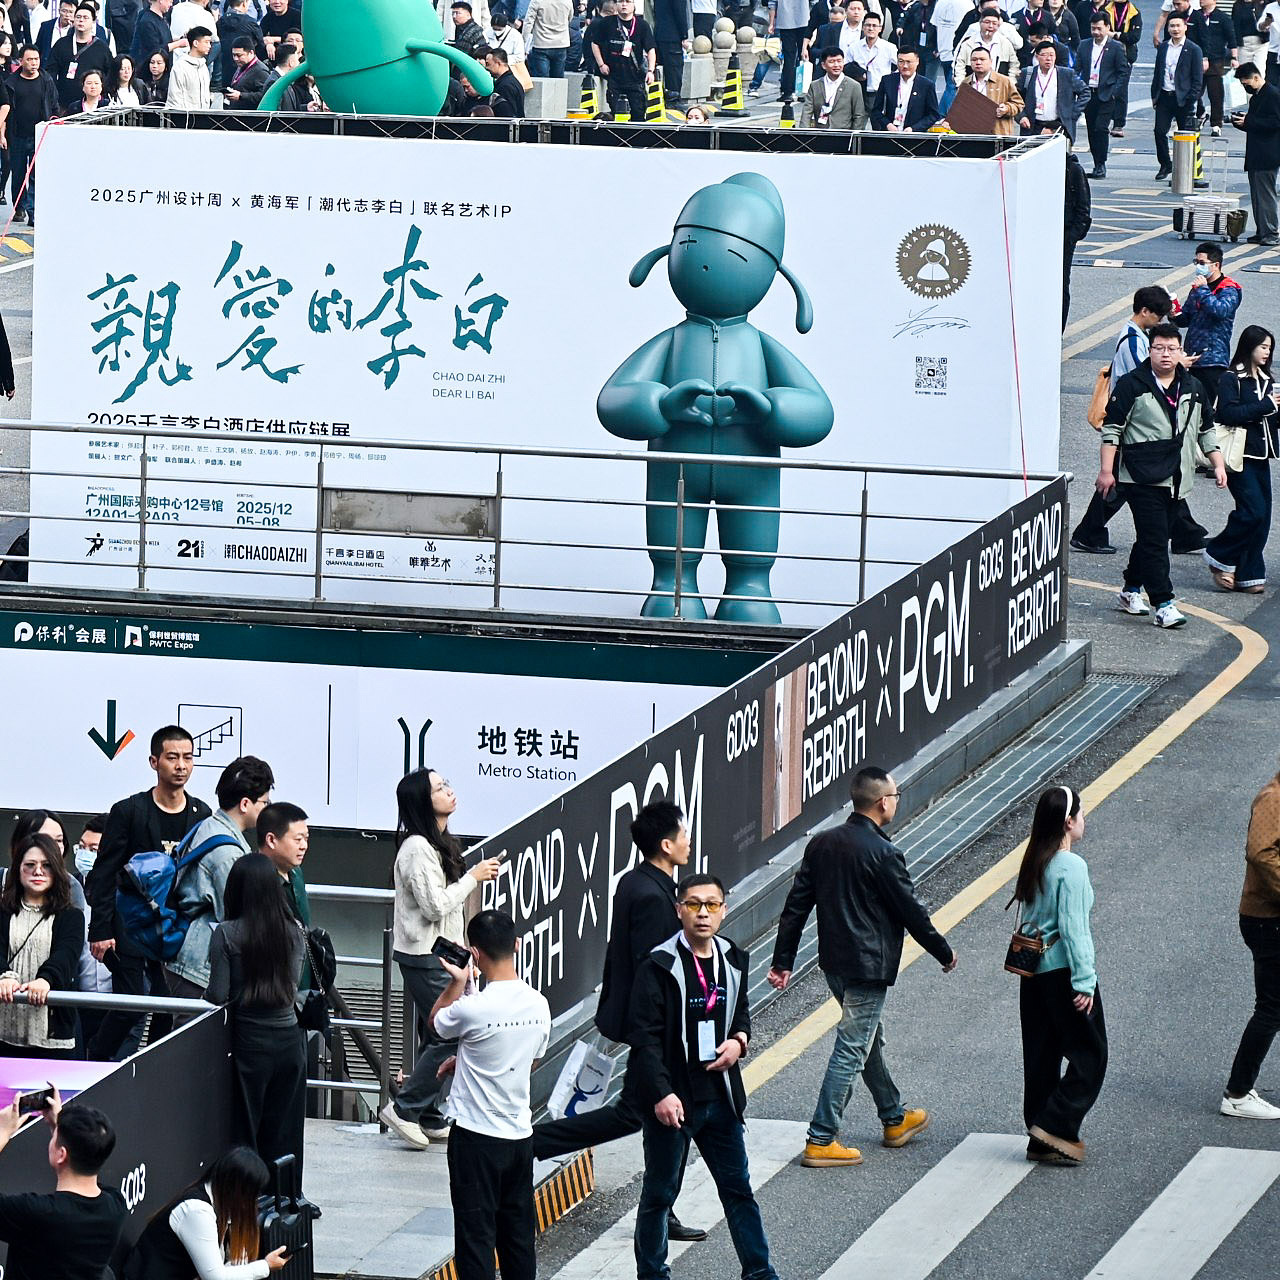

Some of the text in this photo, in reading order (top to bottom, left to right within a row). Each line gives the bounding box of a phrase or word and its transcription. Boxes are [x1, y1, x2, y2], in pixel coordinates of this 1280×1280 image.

[90, 188, 223, 209] 2025广州设计周
[432, 372, 506, 384] CHAO DAI ZHI
[433, 389, 495, 401] DEAR LI BAI
[236, 501, 293, 516] 2025/12
[1010, 502, 1061, 588] BEYOND
[366, 561, 385, 569] HOTEL
[1007, 566, 1061, 659] REBIRTH
[36, 624, 107, 645] 保利 会展
[148, 630, 200, 643] 保利世贸博览馆
[149, 639, 194, 650] PWTC Expo
[806, 629, 869, 728] BEYOND
[477, 724, 581, 761] 地铁站
[802, 704, 867, 803] REBIRTH
[478, 762, 578, 782] Metro Station
